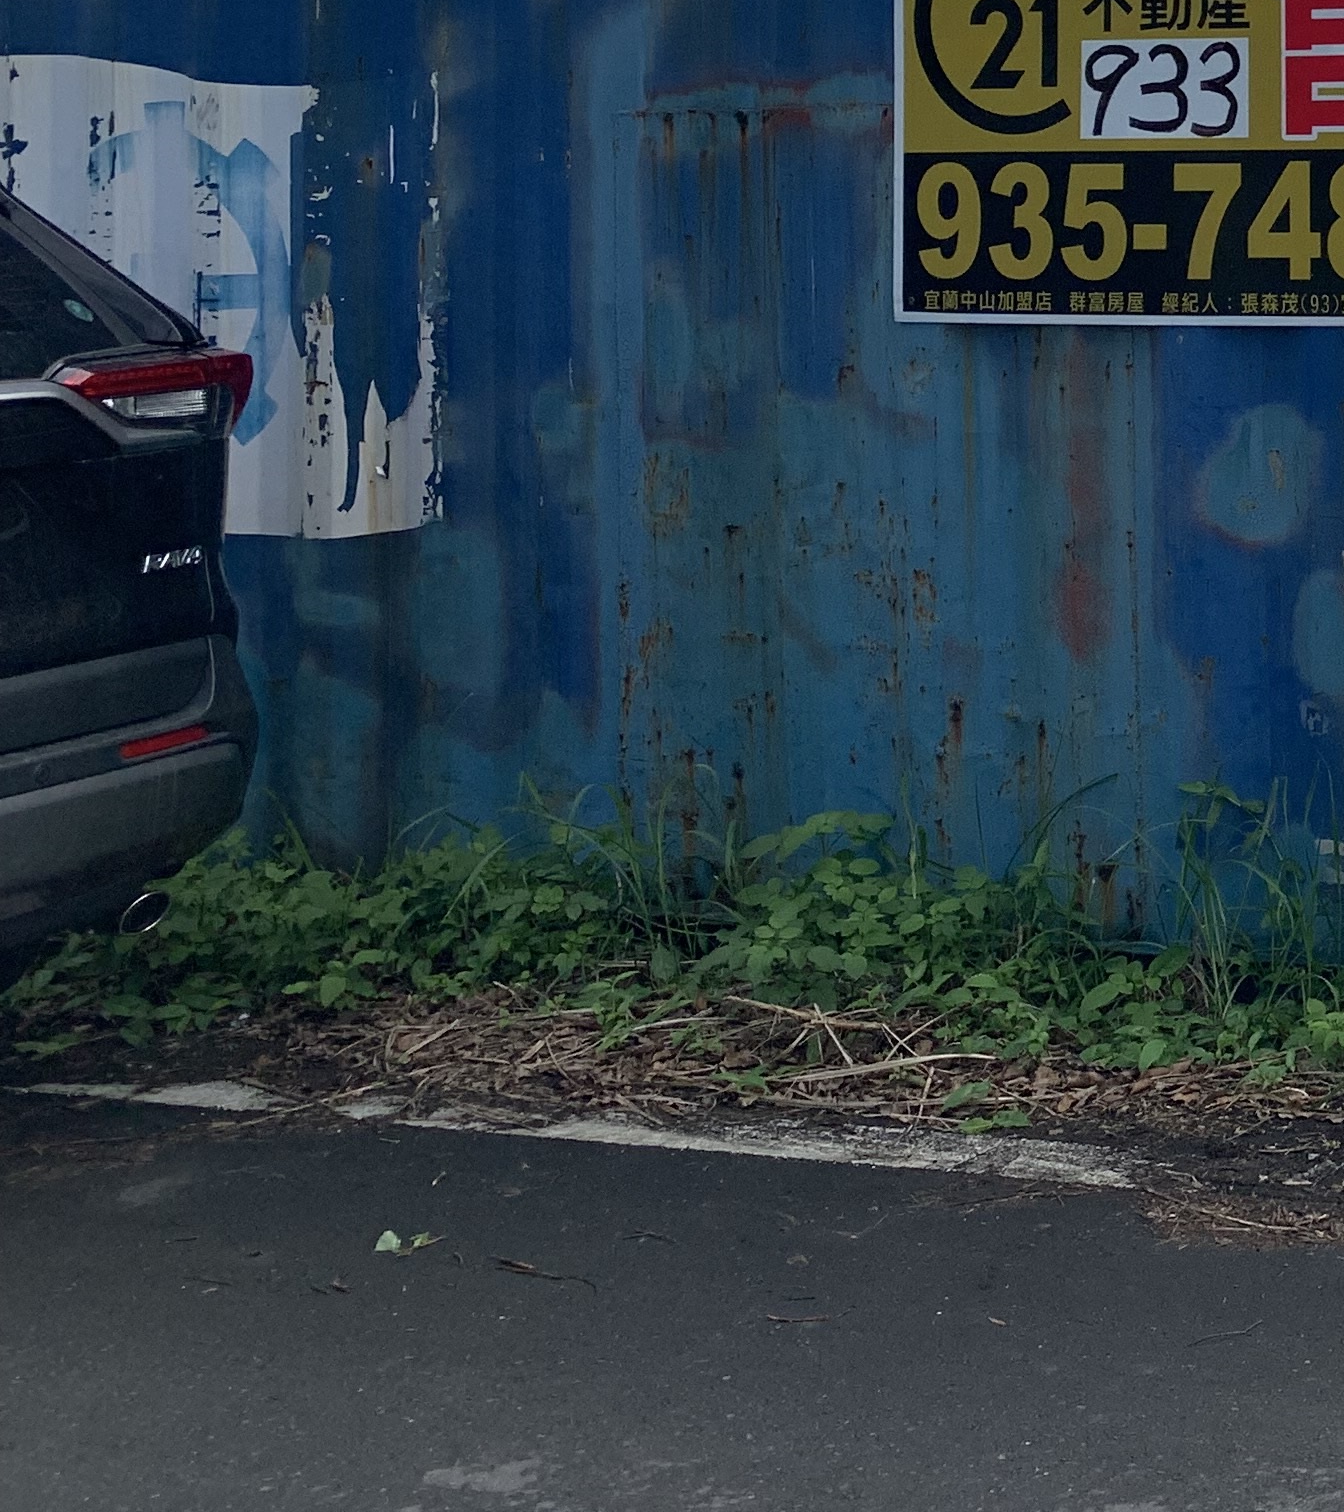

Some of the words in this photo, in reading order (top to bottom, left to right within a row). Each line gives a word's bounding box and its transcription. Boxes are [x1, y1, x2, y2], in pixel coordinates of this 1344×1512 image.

[1084, 40, 1241, 137] 933
[924, 290, 1052, 311] 宜蘭中山加盟店
[1069, 291, 1144, 313] 群富房屋
